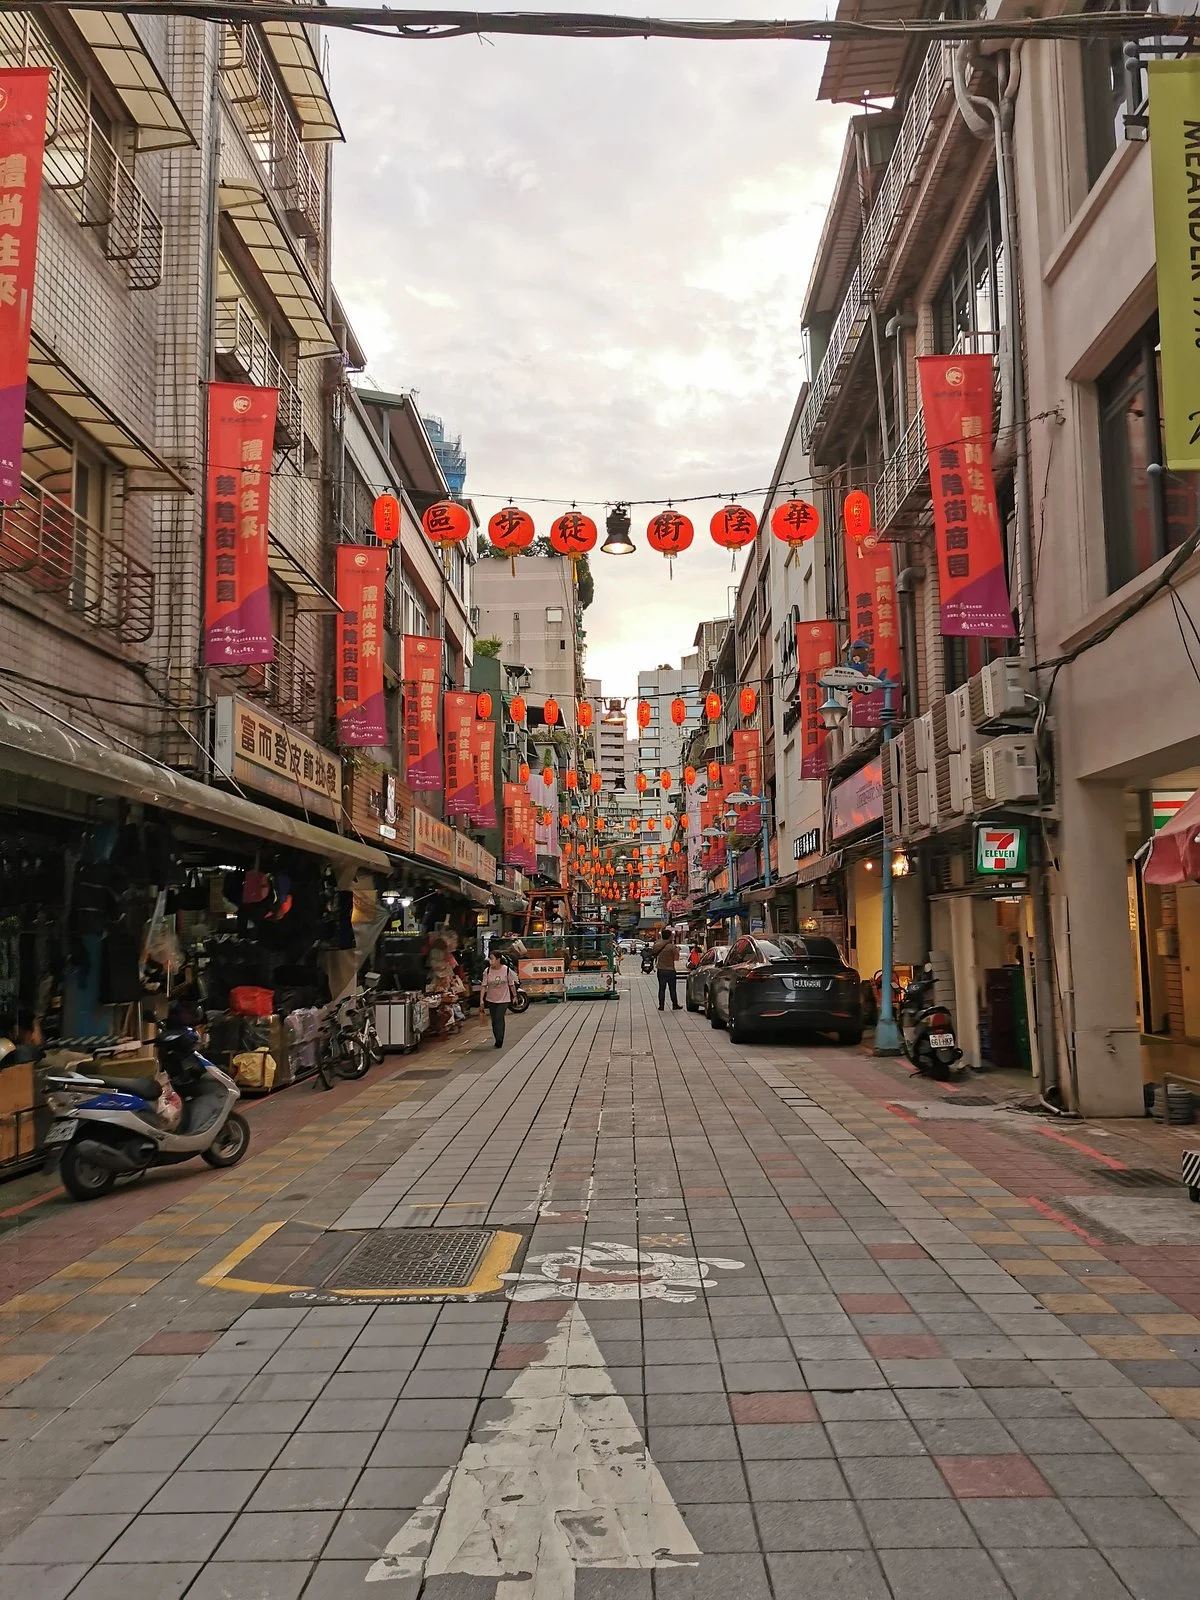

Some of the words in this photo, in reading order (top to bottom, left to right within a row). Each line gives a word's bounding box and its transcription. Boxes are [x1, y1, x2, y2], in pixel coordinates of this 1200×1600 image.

[240, 439, 263, 538] 禮尚往來
[426, 505, 451, 532] 區
[494, 511, 525, 537] 步
[560, 515, 586, 544] 徒
[653, 513, 684, 542] 街
[724, 507, 754, 535] 陰
[783, 503, 814, 531] 華
